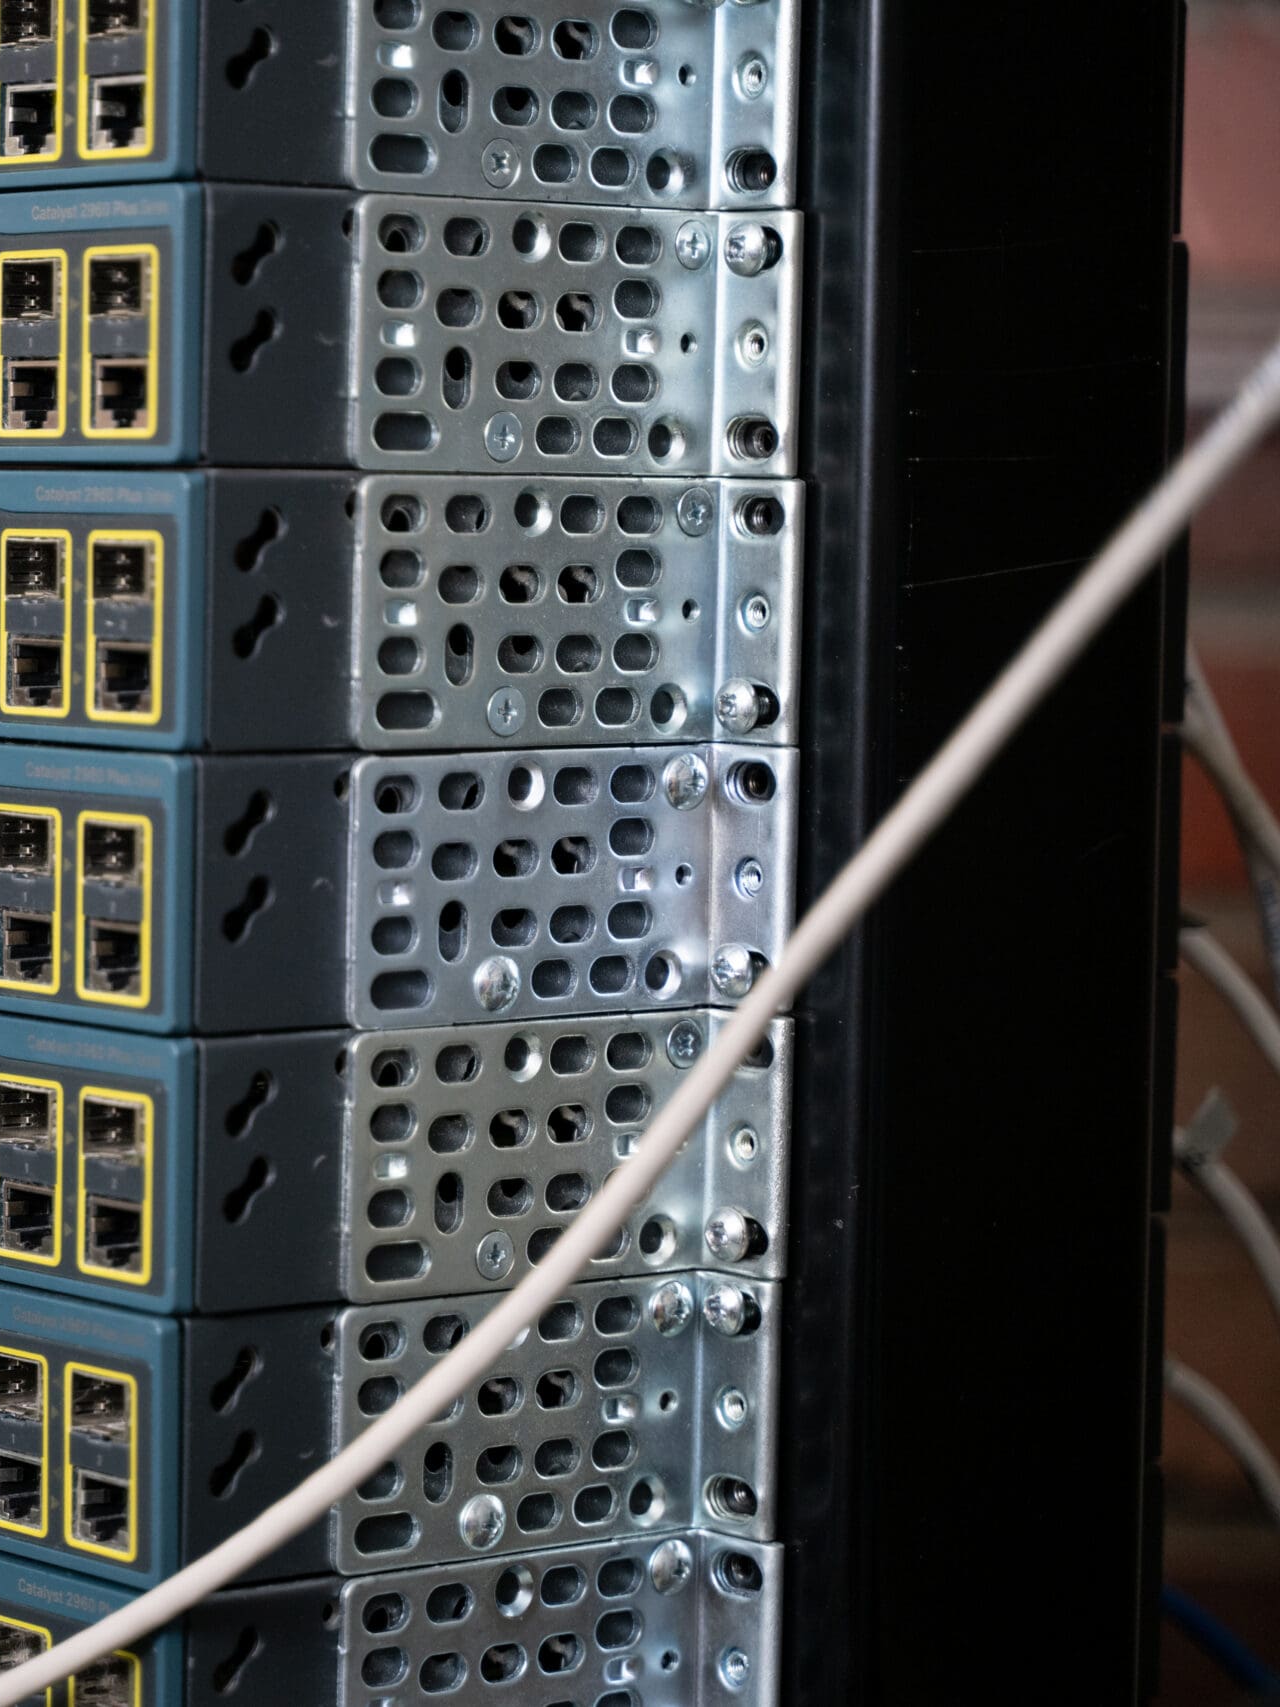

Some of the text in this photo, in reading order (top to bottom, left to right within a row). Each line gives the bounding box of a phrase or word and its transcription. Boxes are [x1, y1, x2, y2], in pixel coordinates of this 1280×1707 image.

[31, 204, 77, 222] Catalyst
[35, 485, 81, 503] Catalyst
[17, 1577, 63, 1603] Catalyst
[65, 1591, 96, 1612] 2960
